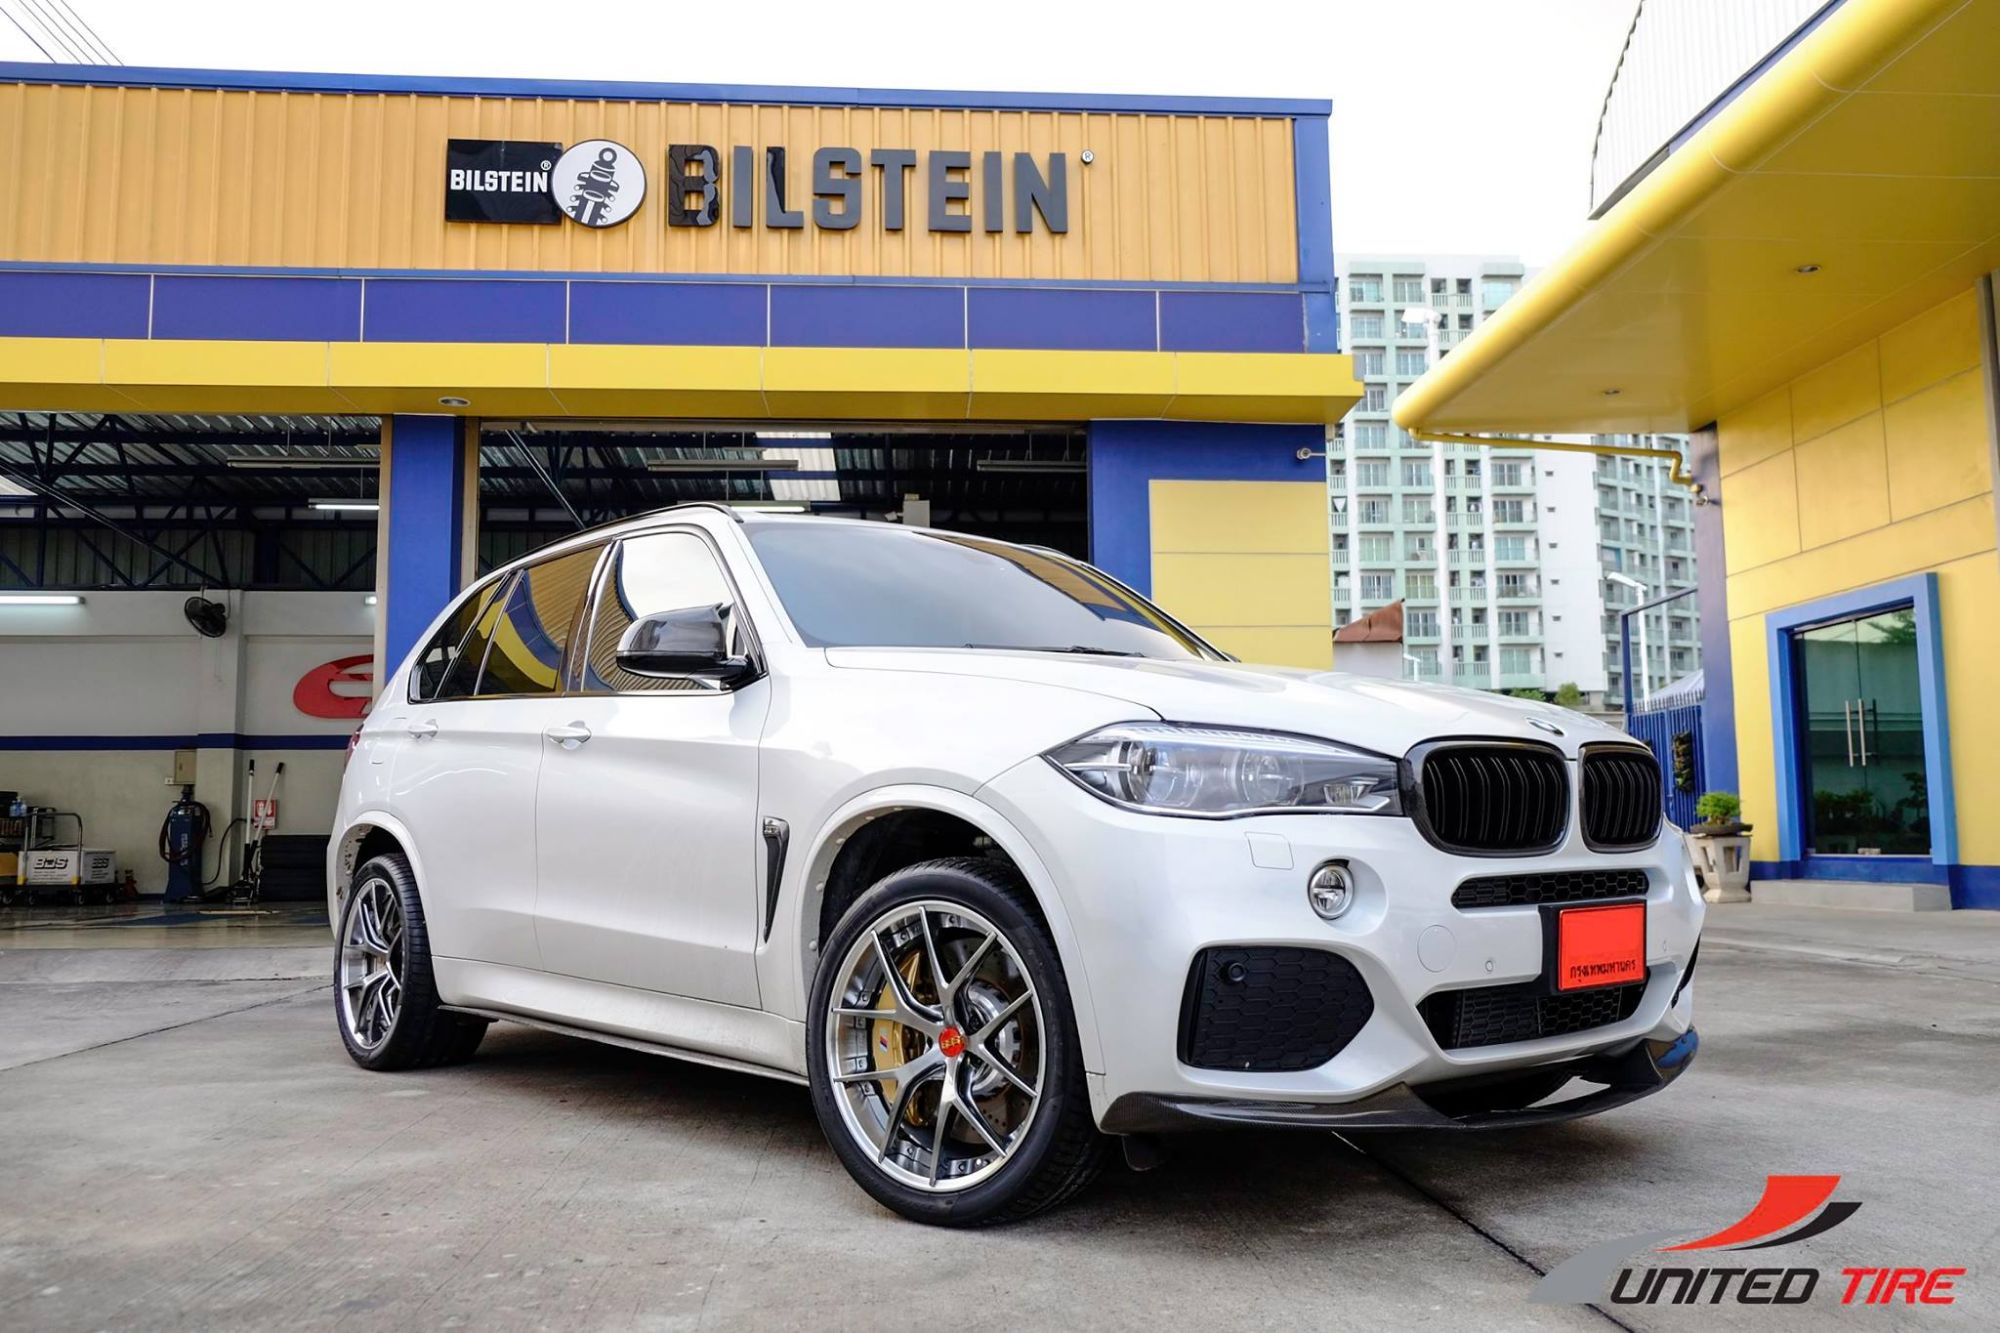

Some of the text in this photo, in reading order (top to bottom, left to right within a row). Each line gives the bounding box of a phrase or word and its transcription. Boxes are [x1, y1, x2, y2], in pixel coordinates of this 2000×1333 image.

[667, 143, 1068, 235] BILSTEIN
[1569, 959, 1637, 983] กรุงเทพมหานคร
